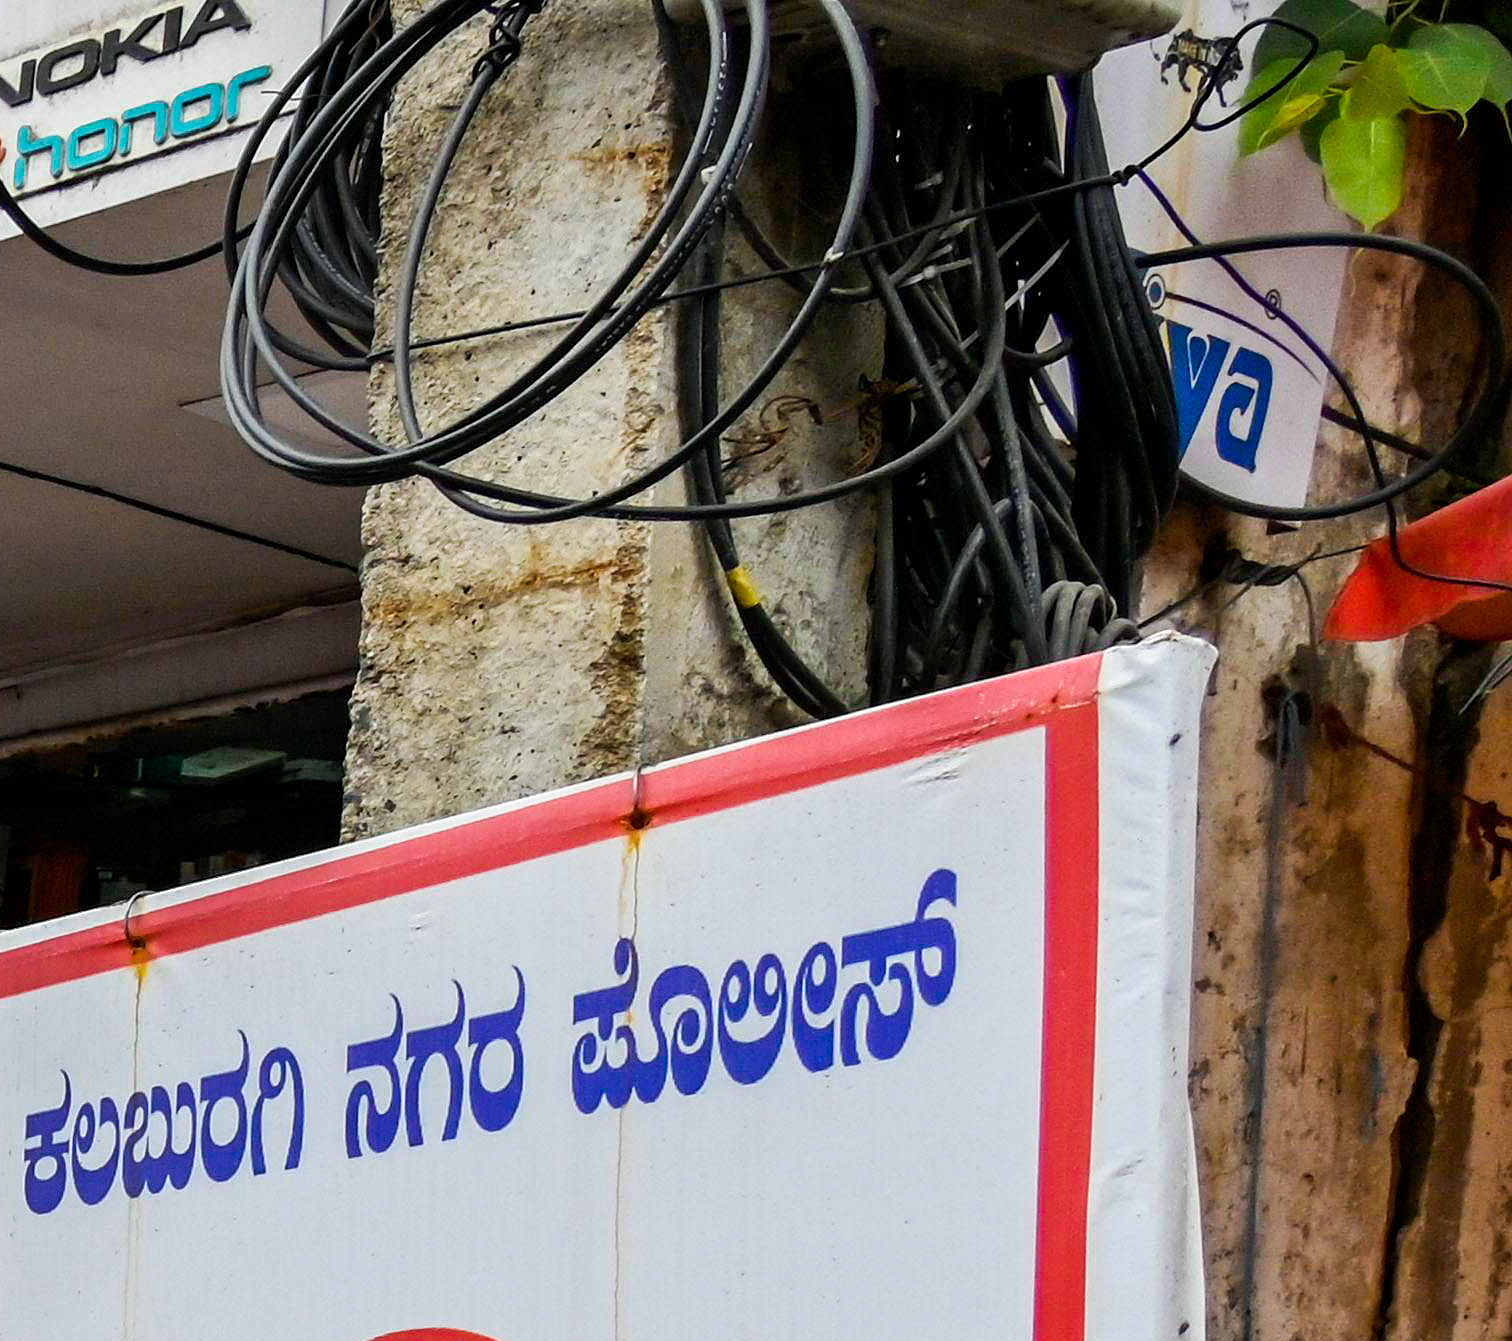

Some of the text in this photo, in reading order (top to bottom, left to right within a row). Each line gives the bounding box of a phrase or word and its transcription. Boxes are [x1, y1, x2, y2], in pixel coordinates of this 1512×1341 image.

[13, 65, 273, 191] honor
[24, 1027, 306, 1216] ಕಲಬುರಗಿ
[346, 965, 525, 1159] ನಗರ
